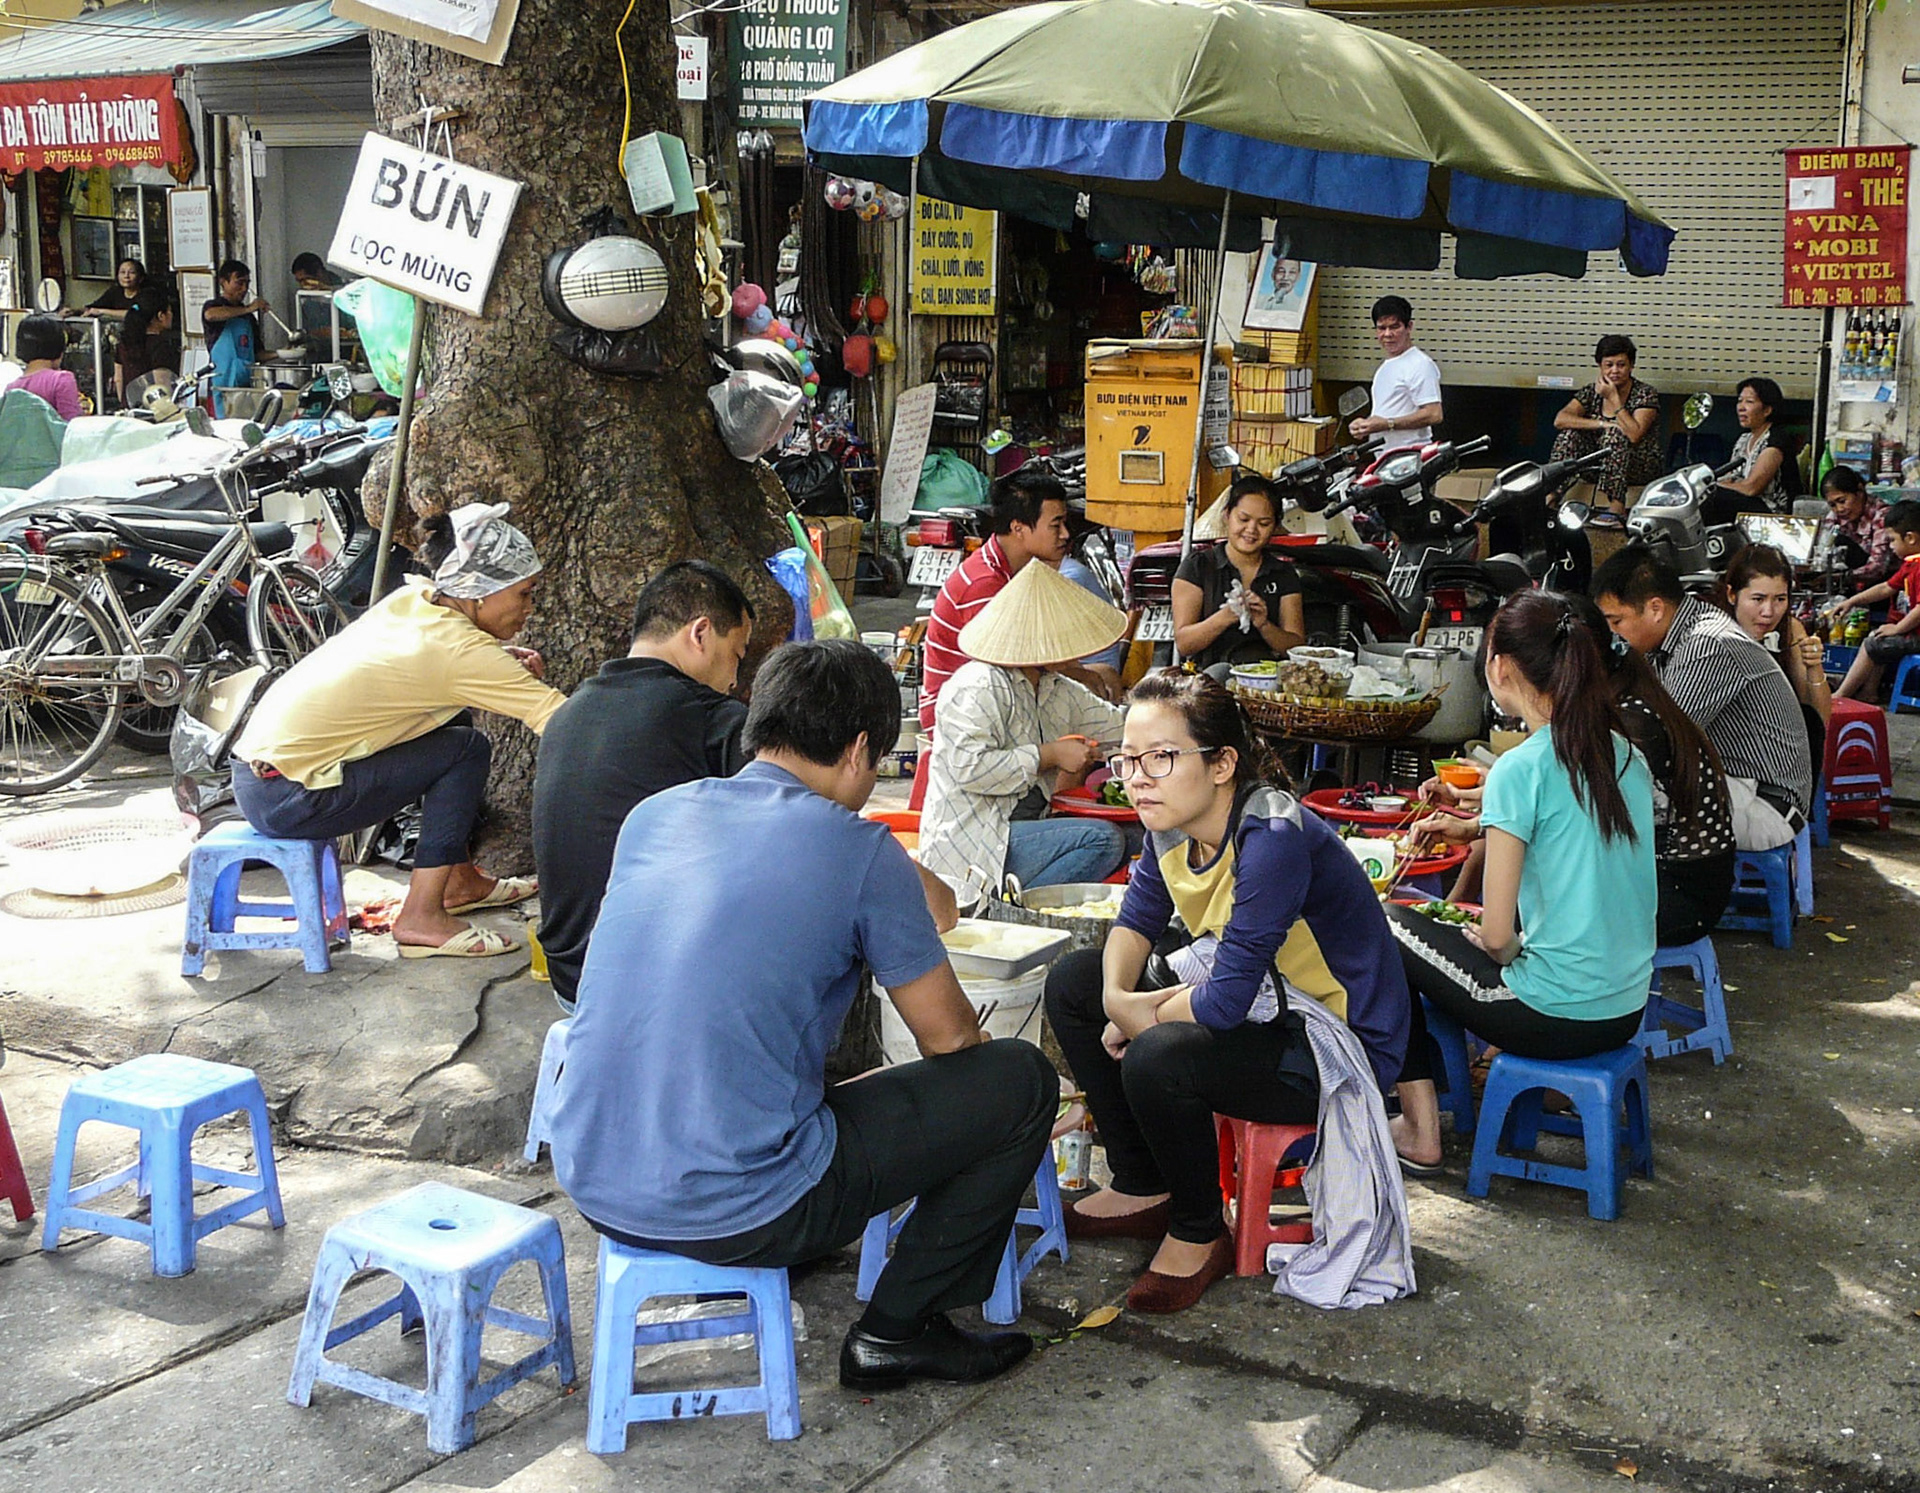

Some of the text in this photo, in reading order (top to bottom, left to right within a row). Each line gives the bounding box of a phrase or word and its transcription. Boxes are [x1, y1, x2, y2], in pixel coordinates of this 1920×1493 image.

[743, 16, 834, 55] QUẢNG LỢI
[754, 55, 776, 80] PHỐ
[806, 58, 835, 83] XUÂN
[3, 106, 29, 147] ĐA
[28, 98, 68, 146] TÔM
[69, 92, 99, 144] HẢI
[102, 93, 160, 143] PHÒNG
[43, 149, 93, 165] 39785666
[371, 158, 491, 239] BÚN
[1807, 215, 1880, 232] VINA
[1808, 239, 1879, 257] MOBI
[401, 252, 472, 293] MÙNG
[1803, 263, 1895, 281] VIETTEL
[1118, 393, 1140, 407] ĐIỆN
[1142, 393, 1162, 408] VIỆT
[1165, 395, 1188, 406] NAM
[1149, 410, 1167, 418] POST
